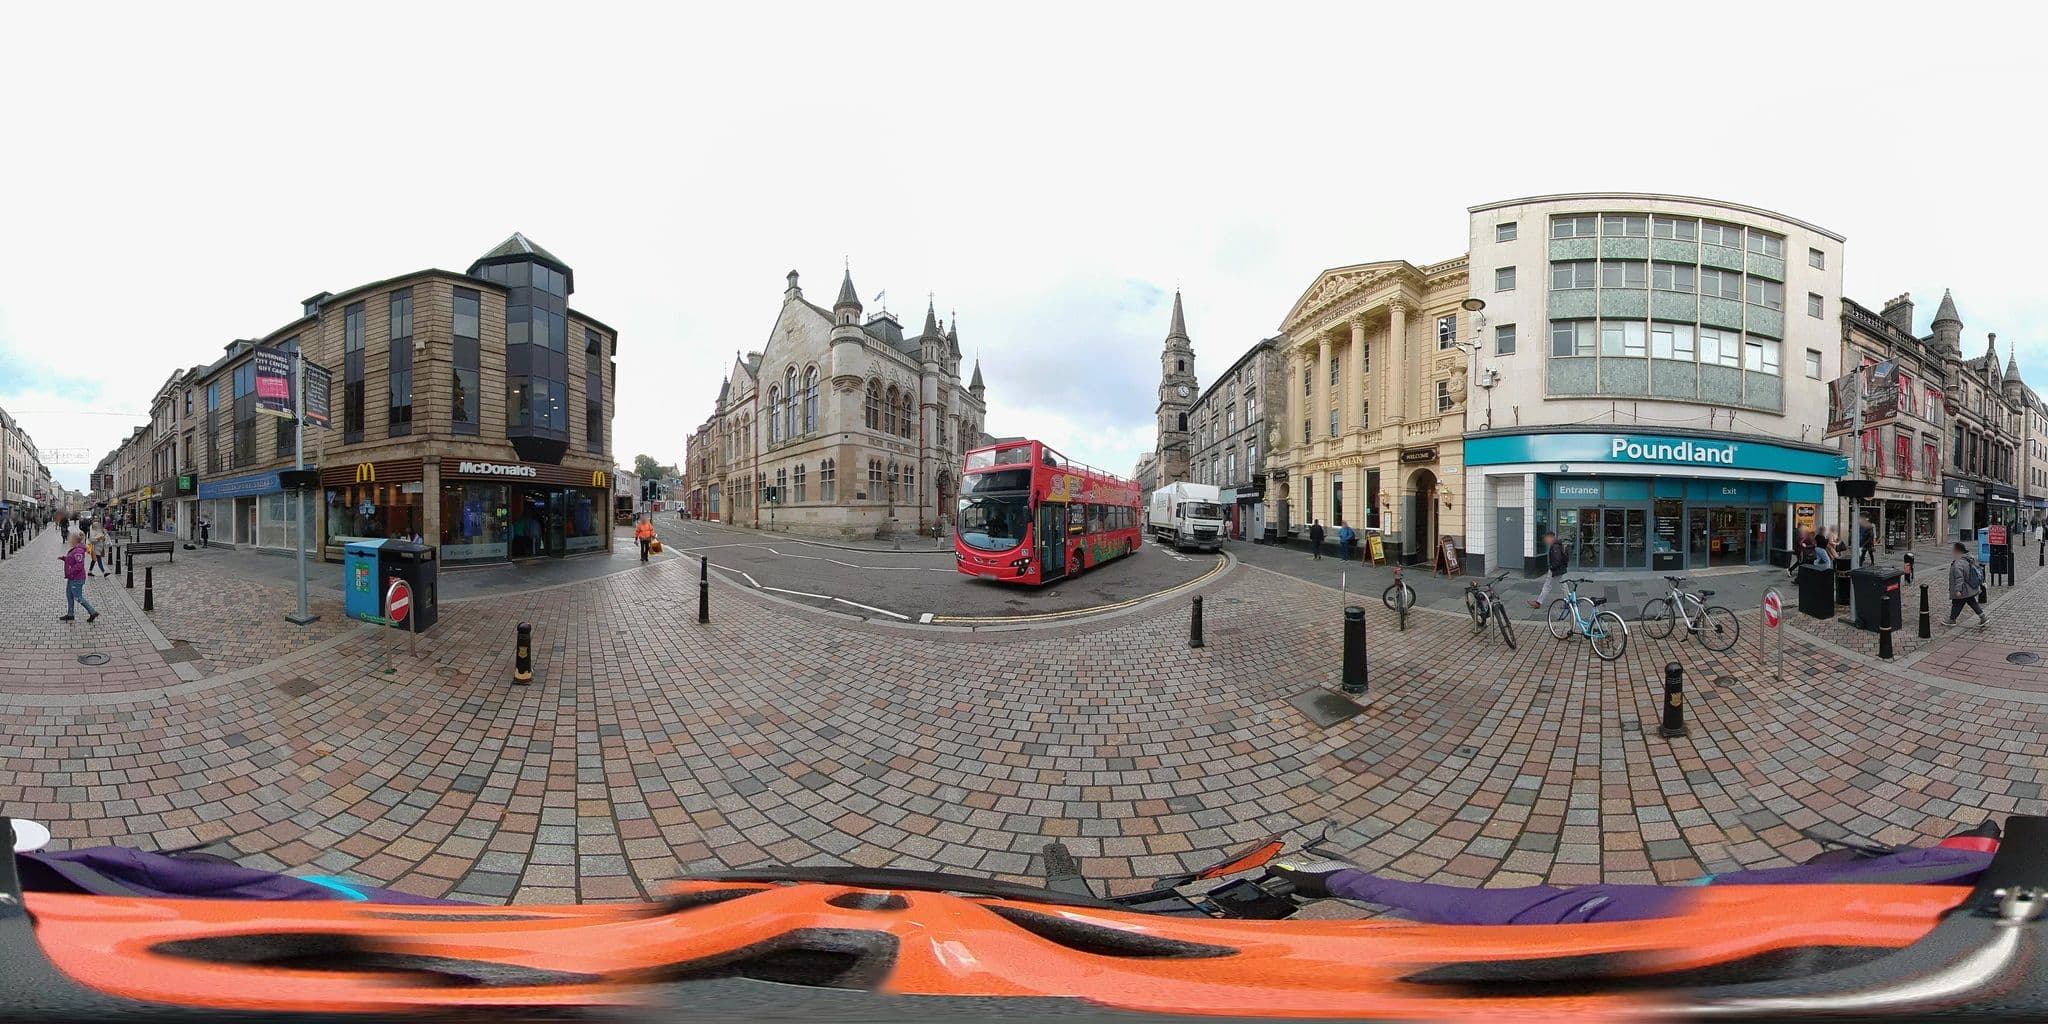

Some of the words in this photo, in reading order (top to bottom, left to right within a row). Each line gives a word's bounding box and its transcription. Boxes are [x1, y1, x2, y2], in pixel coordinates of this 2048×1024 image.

[1323, 298, 1367, 323] CALEDONIAN
[257, 351, 288, 363] INVERNESS
[269, 360, 289, 370] CENTRE
[272, 368, 287, 376] CARD
[1612, 438, 1734, 464] Poundland
[459, 461, 537, 477] McDonald's
[1559, 485, 1599, 495] Entrance
[1722, 487, 1737, 495] Exit
